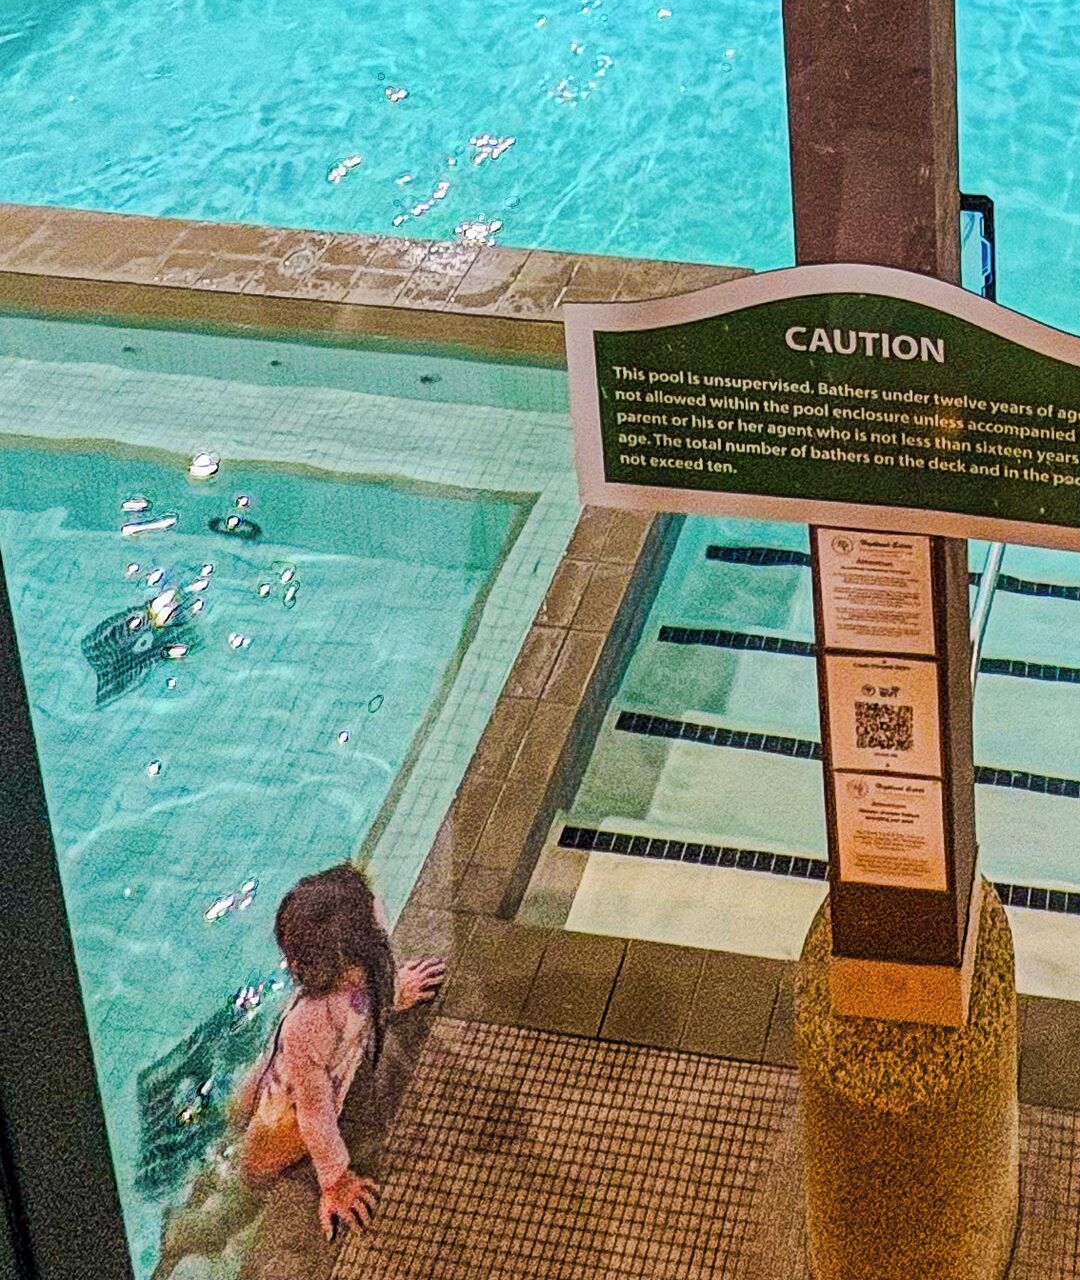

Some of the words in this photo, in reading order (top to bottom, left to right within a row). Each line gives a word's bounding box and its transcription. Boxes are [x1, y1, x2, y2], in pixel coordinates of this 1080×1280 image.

[785, 326, 945, 363] CAUTION
[612, 365, 645, 380] This
[649, 370, 684, 385] pool
[688, 371, 700, 385] is
[703, 374, 814, 395] unsupervised.
[818, 382, 879, 400] Bathers
[882, 391, 929, 404] under
[934, 394, 987, 410] twelve
[990, 401, 1033, 416] years
[1036, 404, 1054, 417] of
[615, 390, 642, 401] not
[645, 392, 707, 407] allowed
[709, 395, 760, 412] within
[763, 400, 789, 414] the
[793, 403, 829, 418] pool
[832, 402, 910, 425] enclosure
[913, 415, 964, 430] unless
[967, 419, 1076, 443] accompanied
[617, 411, 668, 426] parent
[671, 416, 687, 427] or
[691, 415, 714, 429] his
[717, 420, 734, 430] or
[737, 419, 763, 434] her
[767, 422, 814, 439] agent
[816, 425, 851, 441] who
[854, 428, 867, 442] is
[871, 432, 897, 445] not
[901, 433, 931, 448] less
[934, 436, 971, 452] than
[975, 442, 1033, 459] sixteen
[1037, 449, 1080, 466] years
[618, 433, 651, 448] age.
[655, 432, 682, 448] The
[685, 437, 722, 451] total
[725, 441, 787, 457] number
[790, 445, 807, 458] of
[810, 446, 870, 464] bathers
[873, 454, 894, 466] on
[898, 452, 925, 467] the
[928, 456, 966, 473] deck
[970, 463, 1000, 477] and
[1003, 466, 1019, 479] in
[1023, 467, 1049, 482] the
[620, 453, 646, 466] not
[650, 455, 704, 470] exceed
[707, 459, 738, 474] ten.
